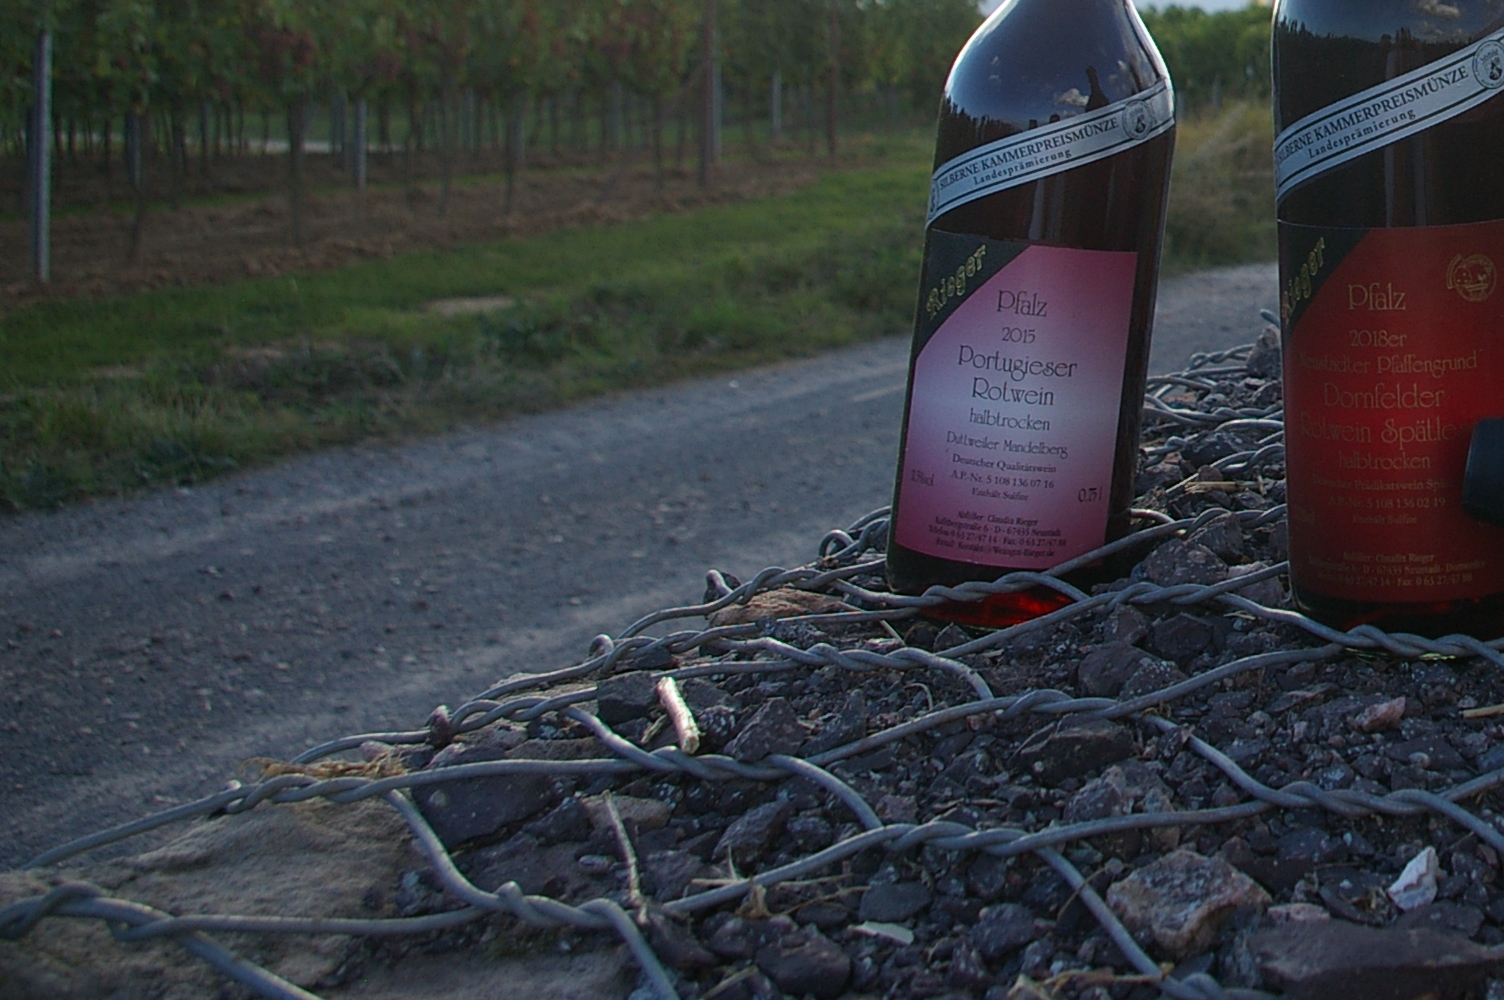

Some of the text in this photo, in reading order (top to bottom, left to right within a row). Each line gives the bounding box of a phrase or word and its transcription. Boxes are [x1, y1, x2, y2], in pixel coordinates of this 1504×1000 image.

[1313, 65, 1469, 145] KAMMERPREISMÜNZE
[1307, 108, 1417, 159] Landesprämierung
[940, 117, 1120, 188] SILBERNE KAMMERPREISMÜNZE
[973, 149, 1072, 185] Landesprämierung
[926, 243, 986, 320] Rieger
[997, 290, 1048, 317] Pfalz
[1348, 282, 1406, 311] Pfalz
[1001, 326, 1036, 344] 2015
[1349, 329, 1408, 348] 2018er
[957, 345, 1078, 382] Portugieser
[1377, 350, 1477, 378] Pfaffengrund
[972, 377, 1054, 406] Rotwein
[1323, 382, 1445, 409] Dornfelder
[969, 407, 1050, 431] halbtrocken
[1301, 412, 1371, 443] Rotwein
[946, 430, 1068, 460] Duttweiler Mandelberg
[1338, 449, 1431, 470] halbtrocken
[985, 475, 992, 484] 5
[994, 476, 1010, 486] 108
[1012, 477, 1029, 488] 136
[1029, 479, 1042, 488] 07
[1043, 480, 1055, 489] 16
